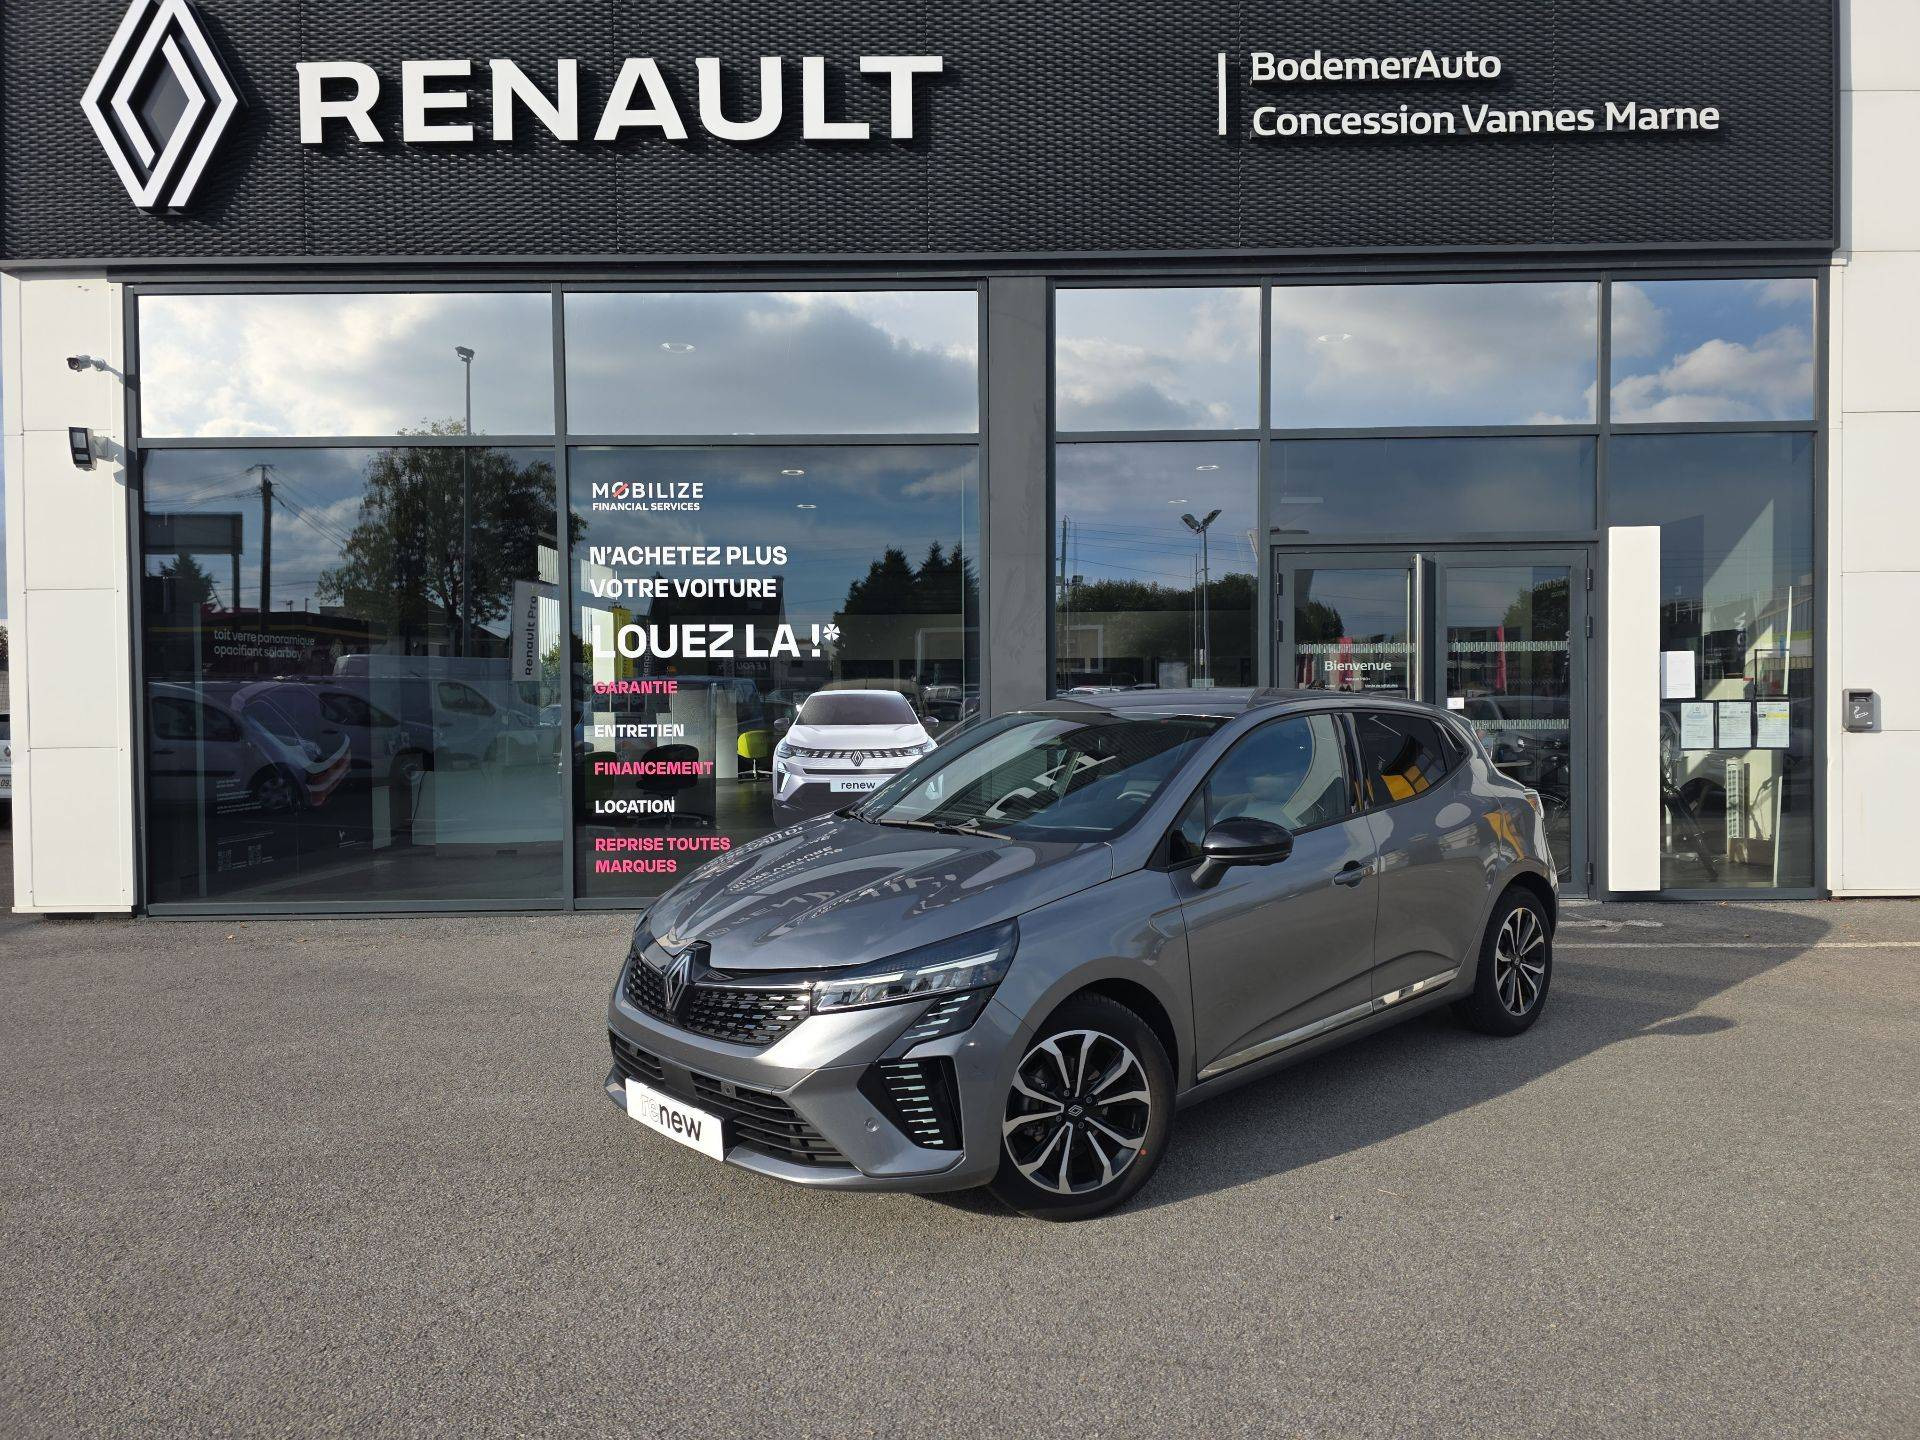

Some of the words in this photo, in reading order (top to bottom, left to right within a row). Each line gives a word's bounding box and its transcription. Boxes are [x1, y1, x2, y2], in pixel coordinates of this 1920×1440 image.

[1250, 49, 1502, 82] BodemerAuto
[295, 55, 944, 145] RENAULT
[1252, 104, 1456, 137] Concession
[1461, 104, 1595, 133] Vannes
[1604, 101, 1721, 131] Marne
[592, 482, 704, 500] MOBILIZE
[592, 502, 649, 512] FINANCIAL
[651, 502, 701, 511] SERVICES
[589, 546, 721, 566] N'ACHETEZ
[726, 546, 788, 566] PLUS
[590, 578, 669, 598] VOTRE
[675, 578, 777, 598] VOITURE
[214, 629, 231, 640] toit
[232, 632, 257, 643] verre
[257, 634, 315, 649] panoramique
[592, 624, 734, 658] LOUEZ
[745, 624, 801, 658] LA
[214, 644, 263, 658] opacifiant
[525, 621, 536, 676] Renault
[1324, 660, 1392, 671] Bienvenue
[594, 680, 678, 695] GARANTIE
[594, 724, 685, 738] ENTRETIEN
[594, 761, 714, 776] FINANCEMENT
[841, 782, 876, 790] renew
[595, 799, 676, 814] LOCATION
[594, 837, 664, 851] REPRISE
[666, 837, 731, 851] TOUTES
[595, 859, 677, 874] MARQUES
